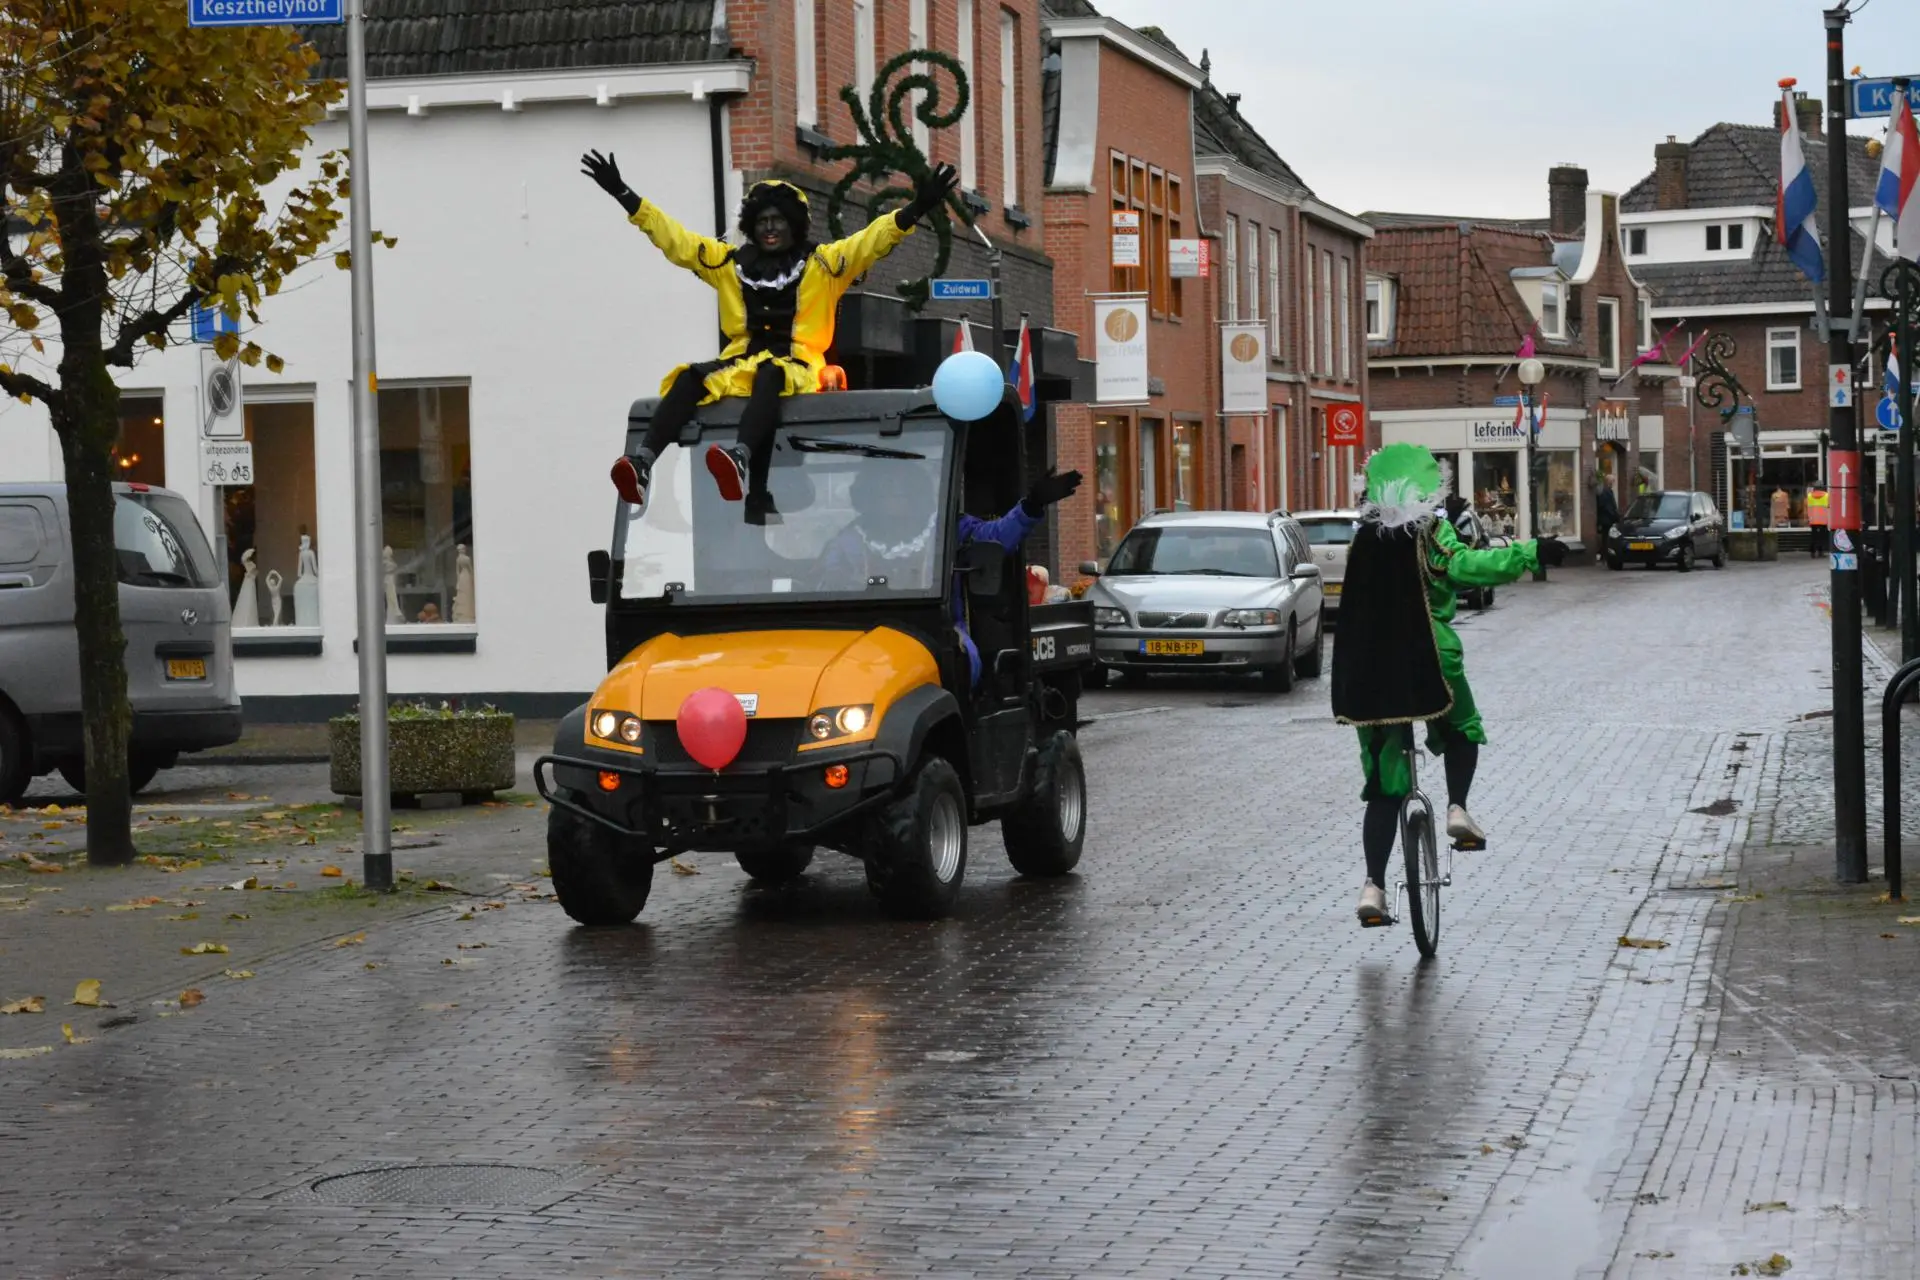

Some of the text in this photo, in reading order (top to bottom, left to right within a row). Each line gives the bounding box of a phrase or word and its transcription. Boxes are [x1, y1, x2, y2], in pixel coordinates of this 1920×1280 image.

[202, 0, 327, 17] Keszthelyhof
[942, 284, 980, 294] Zuidwal
[206, 446, 249, 457] uitgezonderd
[1033, 636, 1055, 661] JCB
[1150, 642, 1198, 653] 18-NB-FP
